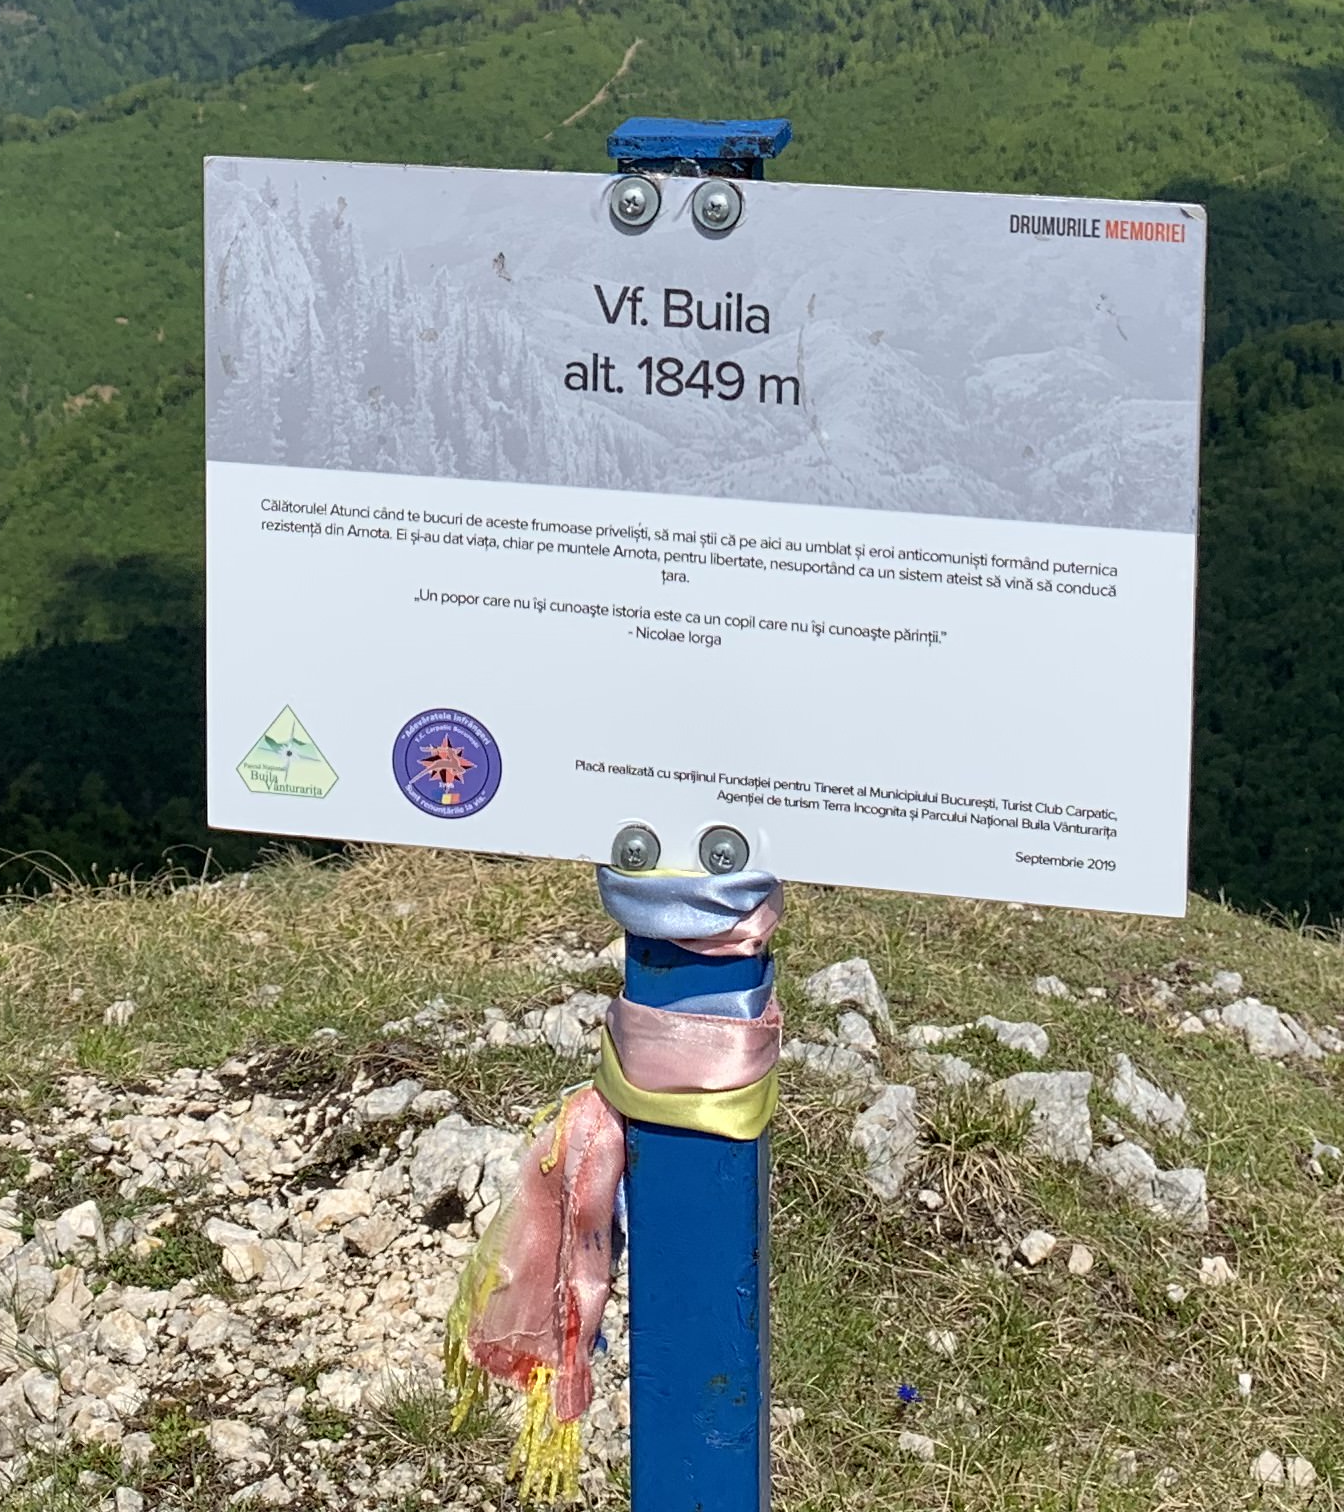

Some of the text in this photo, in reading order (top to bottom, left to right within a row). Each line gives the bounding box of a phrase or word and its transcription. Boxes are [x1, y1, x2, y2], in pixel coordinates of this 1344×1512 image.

[1009, 214, 1186, 243] DRUMURILE MEMORIEI
[593, 284, 770, 334] Vf. Buila
[564, 353, 800, 406] alt. 1849 m
[260, 498, 328, 516] Călătorule!
[329, 503, 371, 519] Atunci
[372, 506, 405, 522] când
[406, 509, 421, 523] te
[423, 509, 463, 526] bucuri
[465, 513, 483, 528] de
[485, 517, 529, 531] aceste
[530, 518, 593, 536] frumoase
[653, 528, 670, 542] să
[672, 530, 697, 544] mai
[720, 533, 737, 547] că
[739, 537, 757, 551] pe
[759, 536, 782, 551] aici
[784, 540, 803, 552] au
[805, 540, 853, 557] umblat
[868, 545, 895, 560] eroi
[990, 553, 1050, 572] formând
[1052, 561, 1118, 577] puternica
[324, 522, 345, 537] din
[346, 523, 393, 540] Arnota.
[396, 527, 408, 541] Ei
[442, 531, 464, 546] dat
[502, 536, 535, 551] chiar
[536, 541, 555, 555] pe
[556, 542, 611, 558] muntele
[612, 544, 661, 563] Arnota,
[663, 551, 707, 565] pentru
[710, 551, 767, 572] libertate,
[769, 559, 856, 577] nesuportând
[858, 566, 875, 579] ca
[877, 568, 896, 580] un
[898, 567, 943, 584] sistem
[945, 572, 984, 587] ateist
[985, 574, 1002, 589] să
[1004, 576, 1034, 591] vină
[1036, 578, 1053, 593] să
[1056, 582, 1117, 598] conducă
[440, 592, 480, 607] popor
[482, 596, 511, 609] care
[513, 598, 531, 610] nu
[612, 603, 651, 620] istoria
[653, 609, 683, 623] este
[684, 612, 701, 624] ca
[703, 614, 721, 626] un
[724, 615, 756, 631] copil
[758, 619, 789, 632] care
[790, 621, 809, 633] nu
[635, 625, 686, 643] Nicolae
[688, 630, 722, 649] Iorga
[575, 759, 606, 773] Placă
[607, 764, 655, 778] realizată
[656, 769, 671, 779] cu
[672, 770, 716, 784] sprijinul
[773, 780, 811, 793] pentru
[813, 781, 855, 797] Tineret
[856, 785, 867, 797] al
[869, 786, 939, 804] Municipiului
[1000, 798, 1033, 813] Turist
[1034, 801, 1064, 816] Club
[1065, 804, 1118, 822] Carpatic,
[766, 794, 782, 807] de
[783, 796, 820, 810] turism
[822, 799, 851, 813] Terra
[853, 801, 908, 819] Incognita
[920, 808, 968, 824] Parcului
[1021, 817, 1051, 832] Buila
[1015, 851, 1117, 872] Septembrie 2019
